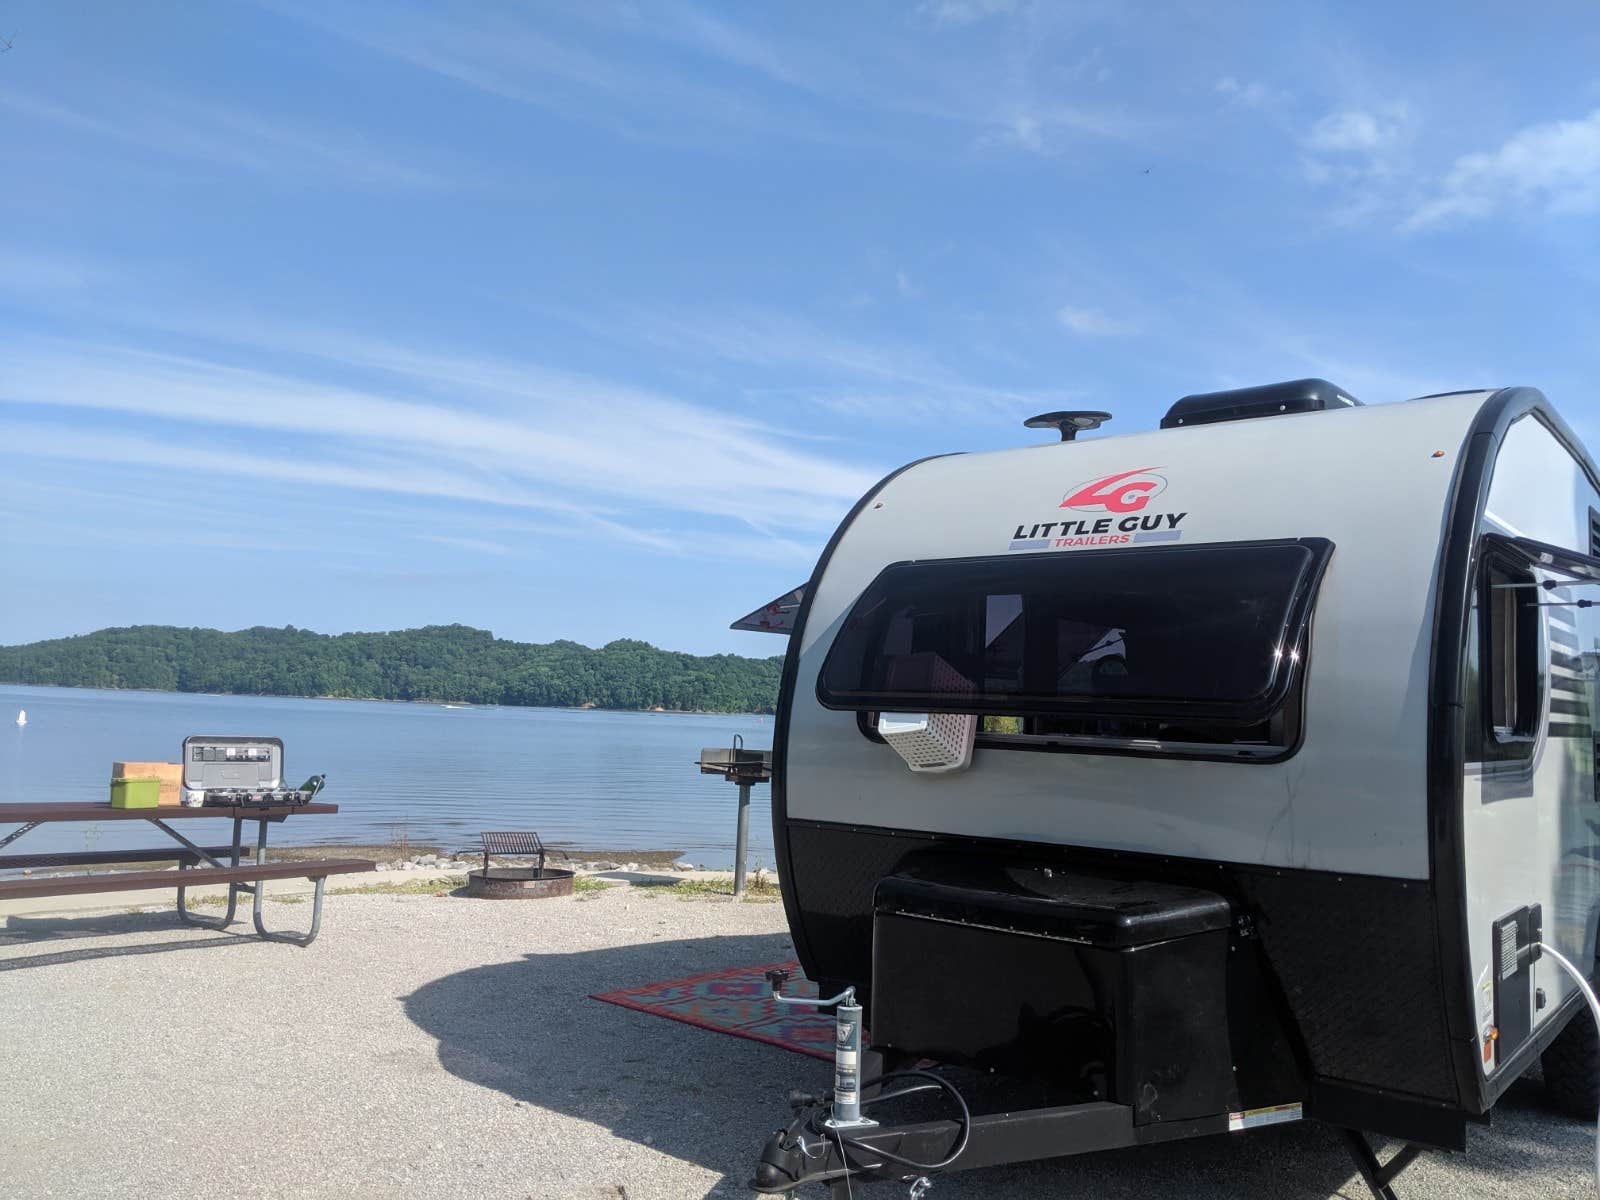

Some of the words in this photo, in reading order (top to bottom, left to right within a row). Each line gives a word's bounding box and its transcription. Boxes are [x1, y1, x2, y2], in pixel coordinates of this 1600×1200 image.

[1013, 518, 1113, 540] LITTLE
[1118, 512, 1189, 533] GUY
[1055, 534, 1131, 548] TRAILERS
